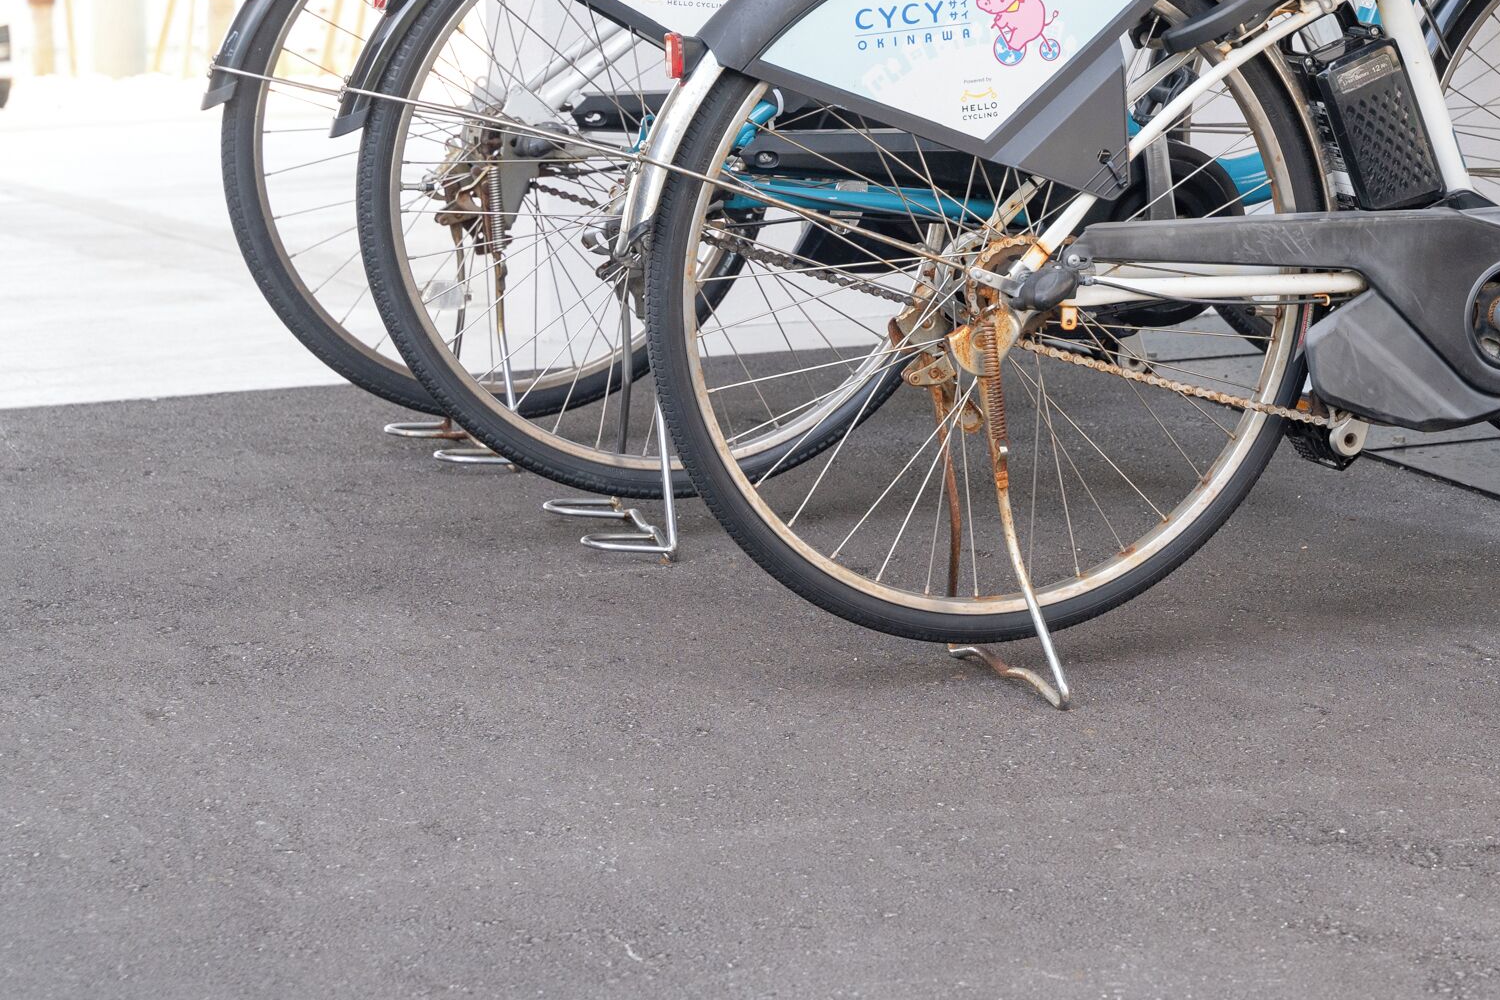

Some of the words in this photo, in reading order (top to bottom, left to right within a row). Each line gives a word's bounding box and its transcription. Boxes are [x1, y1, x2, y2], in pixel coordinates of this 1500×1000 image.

[855, 0, 944, 30] CYCY
[949, 10, 970, 21] サイ
[857, 28, 971, 51] OKINAWA
[961, 101, 998, 113] HELLO
[962, 111, 998, 121] CYCLING
